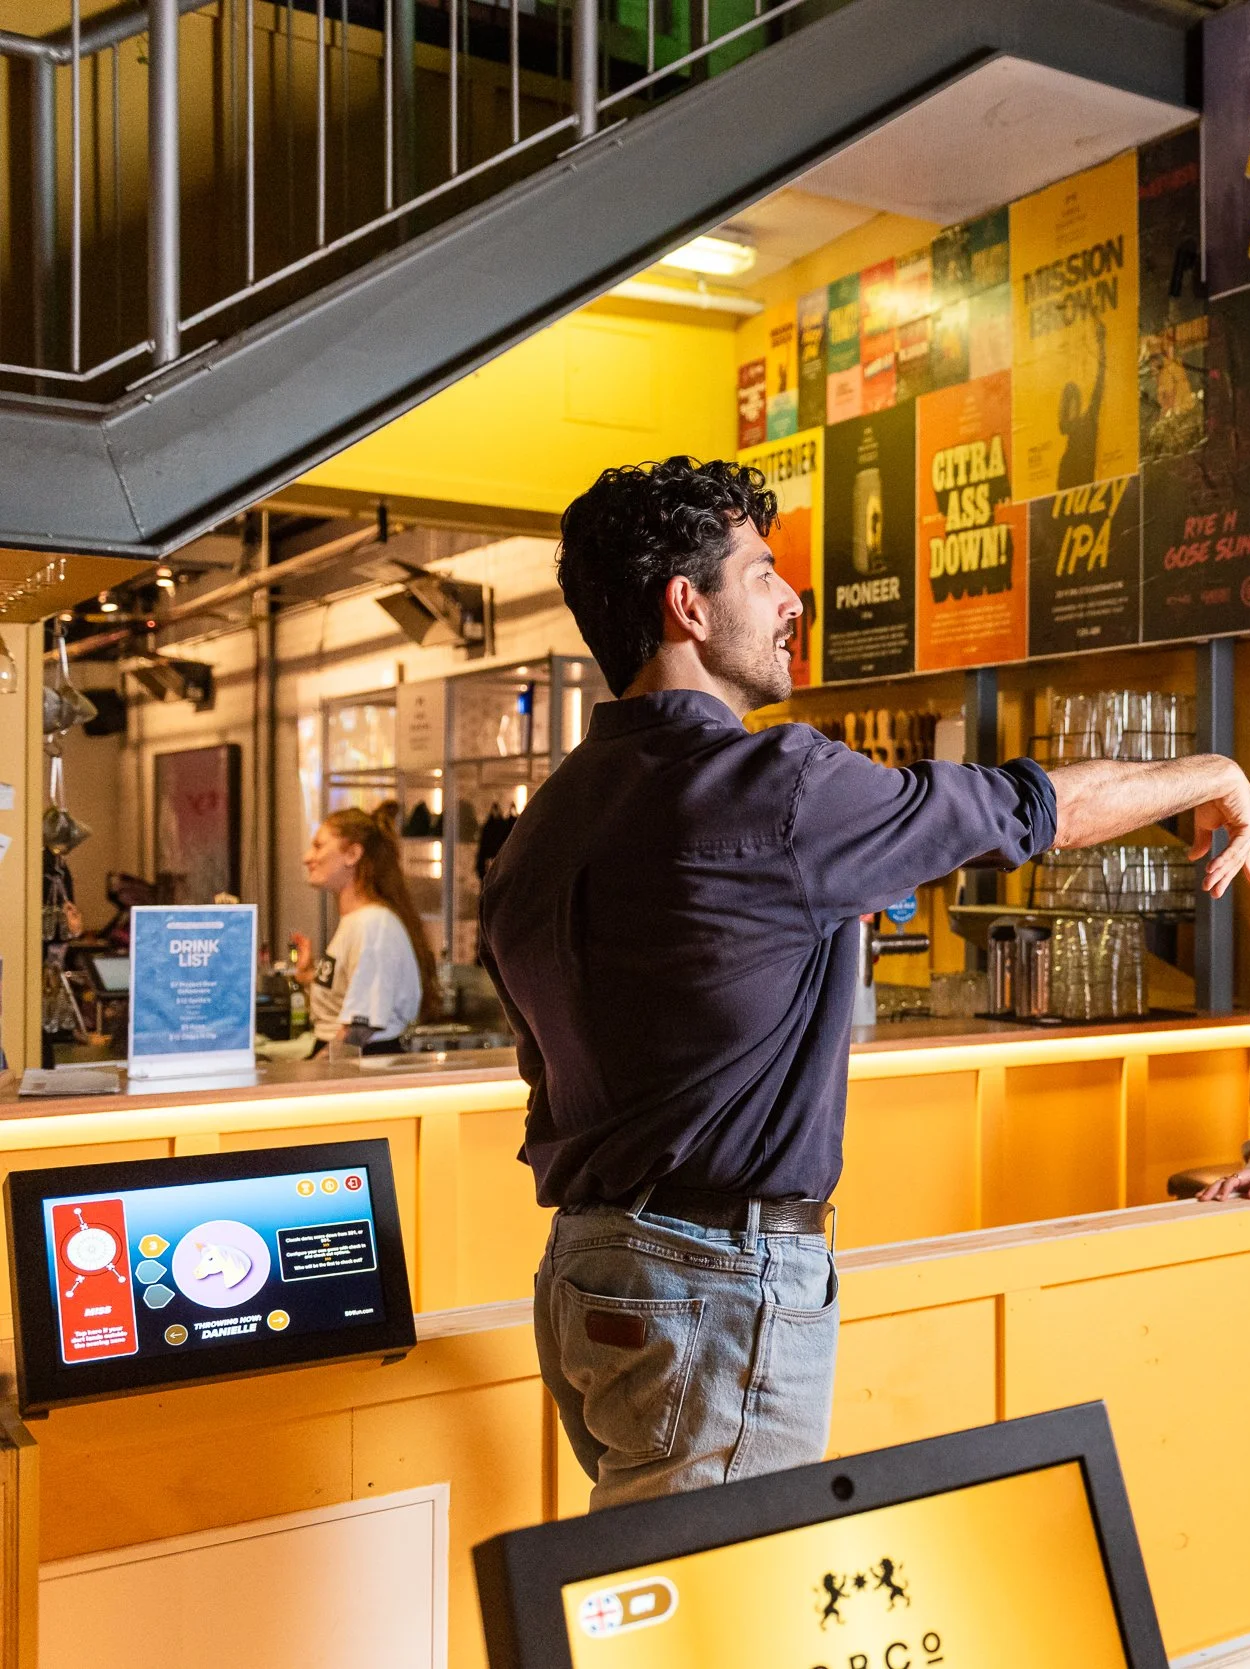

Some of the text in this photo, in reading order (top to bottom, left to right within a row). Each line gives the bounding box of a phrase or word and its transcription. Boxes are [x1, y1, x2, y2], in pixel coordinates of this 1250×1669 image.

[932, 435, 1007, 494] CITRA
[946, 482, 991, 533] ASS
[1184, 512, 1219, 540] RYE
[928, 524, 1009, 580] DOWN!
[1056, 517, 1113, 577] IPA
[1163, 540, 1212, 571] GOSE
[836, 577, 901, 610] PIONEER
[170, 939, 220, 954] DRINK
[178, 952, 212, 968] LIST
[84, 1305, 112, 1318] MISS
[194, 1318, 239, 1331] THROWING
[201, 1323, 258, 1340] DANIELLE
